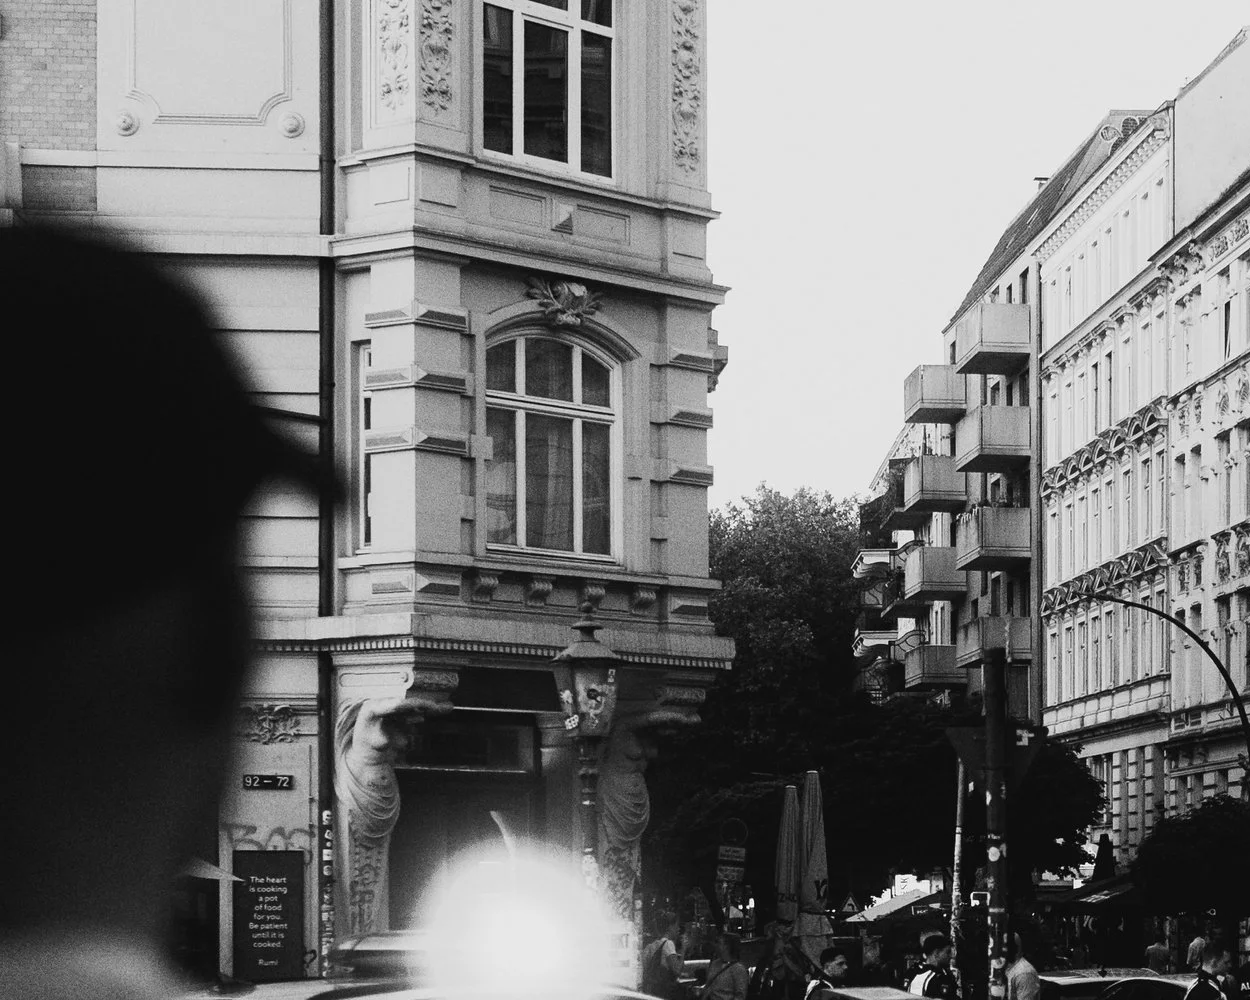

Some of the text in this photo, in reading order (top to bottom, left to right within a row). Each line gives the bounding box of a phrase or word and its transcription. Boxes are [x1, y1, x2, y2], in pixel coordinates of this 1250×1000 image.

[245, 776, 260, 787] 92
[276, 776, 289, 787] 72
[257, 885, 288, 894] cooking
[264, 895, 278, 903] pot
[249, 922, 288, 930] Be patient
